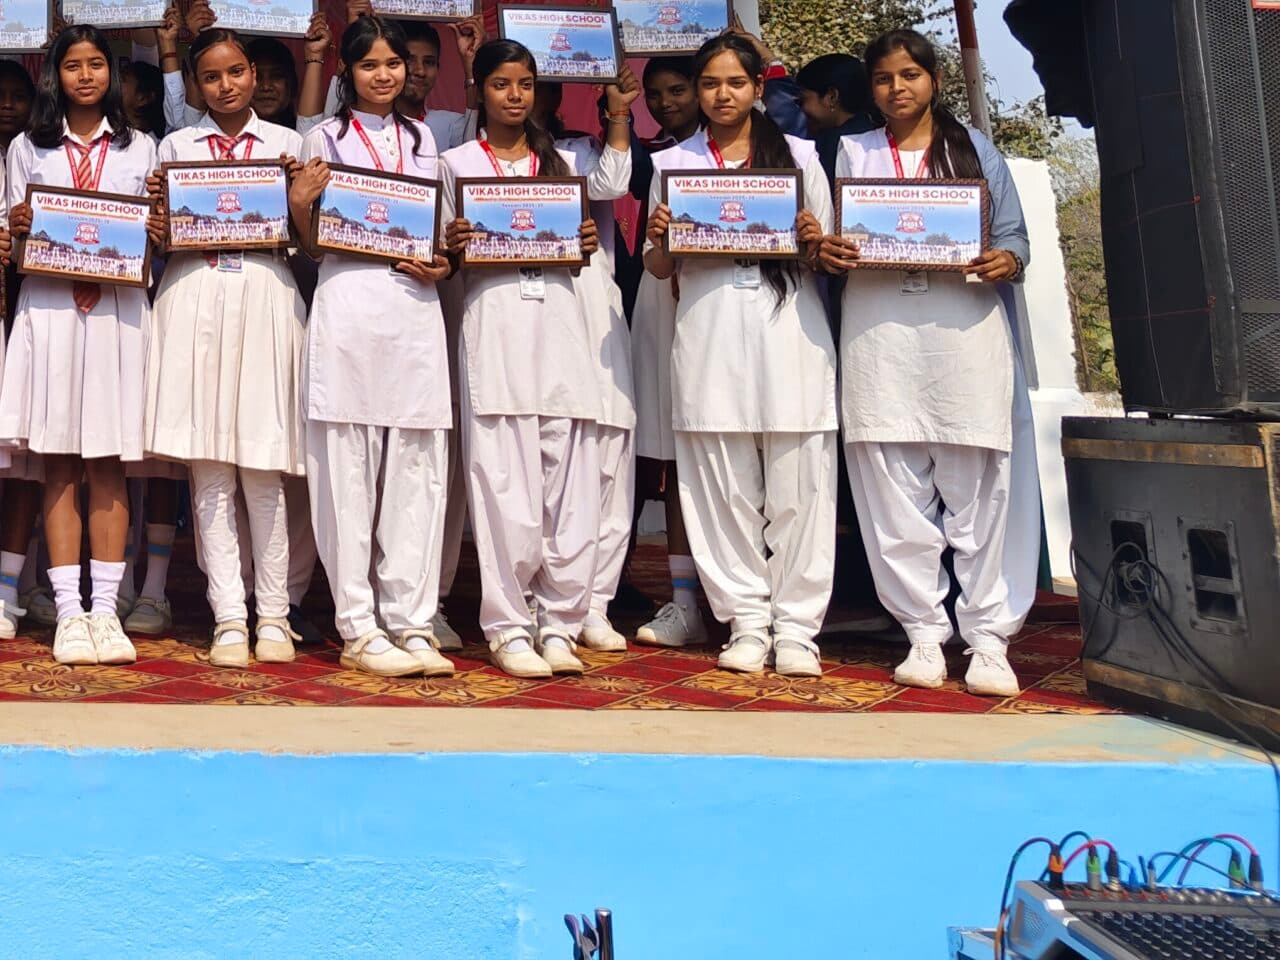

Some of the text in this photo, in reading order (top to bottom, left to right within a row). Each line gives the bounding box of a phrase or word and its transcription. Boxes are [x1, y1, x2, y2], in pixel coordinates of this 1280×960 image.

[507, 13, 607, 23] VIKAS HIGH SCHOOL
[173, 168, 282, 180] VIKAS HIGH SCHOOL
[361, 178, 387, 190] HIGH
[389, 185, 431, 198] SCHOOL
[674, 179, 792, 189] VIKAS HIGH SCHOOL
[468, 186, 577, 196] VIKAS HIGH SCHOOL
[848, 188, 976, 200] VIKAS HIGH SCHOOL
[36, 195, 69, 207] VIKAS
[71, 200, 98, 210] HIGH
[101, 203, 145, 216] SCHOOL
